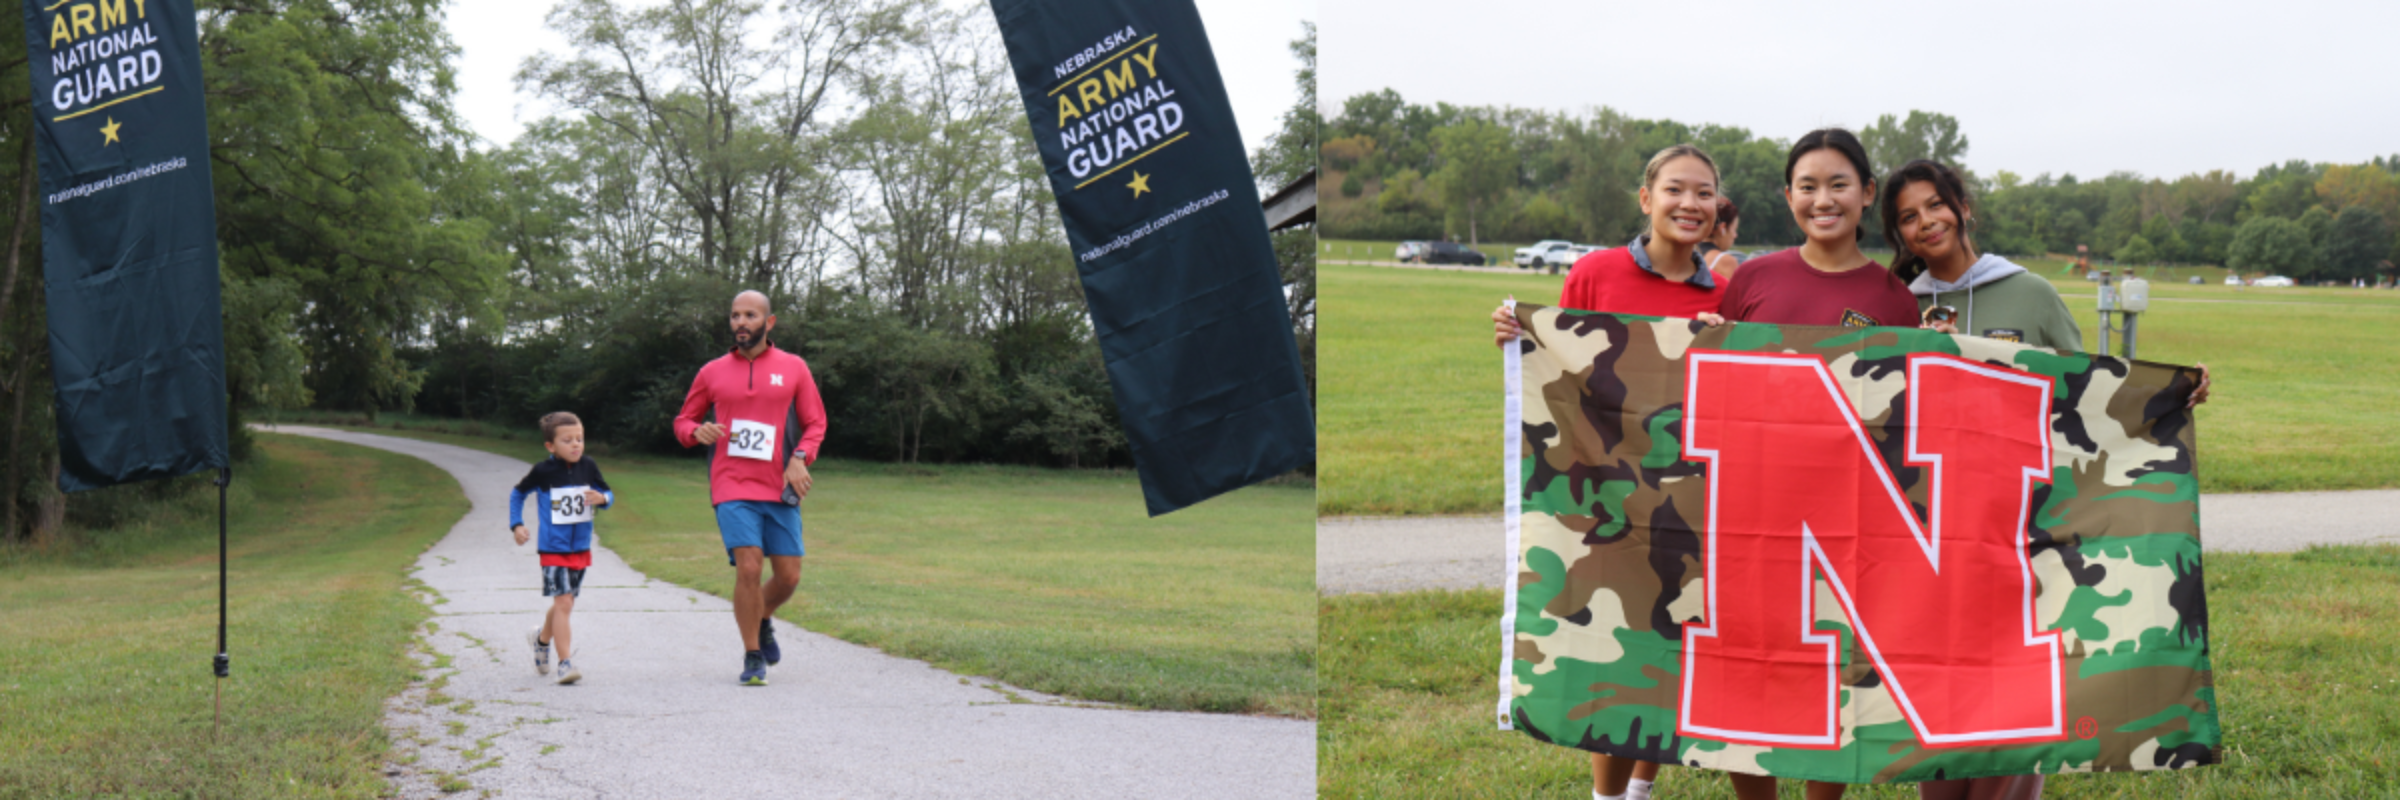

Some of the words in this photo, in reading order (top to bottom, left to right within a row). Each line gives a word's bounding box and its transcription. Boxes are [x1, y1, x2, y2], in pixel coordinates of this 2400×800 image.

[52, 22, 158, 76] NATIONAL
[52, 49, 163, 110] GUARD
[1054, 25, 1137, 79] NEBRASKA
[1057, 43, 1158, 128] ARMY
[1060, 79, 1175, 150] NATIONAL
[1067, 101, 1184, 178] GUARD
[1080, 188, 1230, 263] nationalguard.com/nebraska
[770, 373, 784, 387] N
[738, 427, 766, 451] 32
[561, 494, 585, 517] 33
[1677, 348, 2068, 750] N
